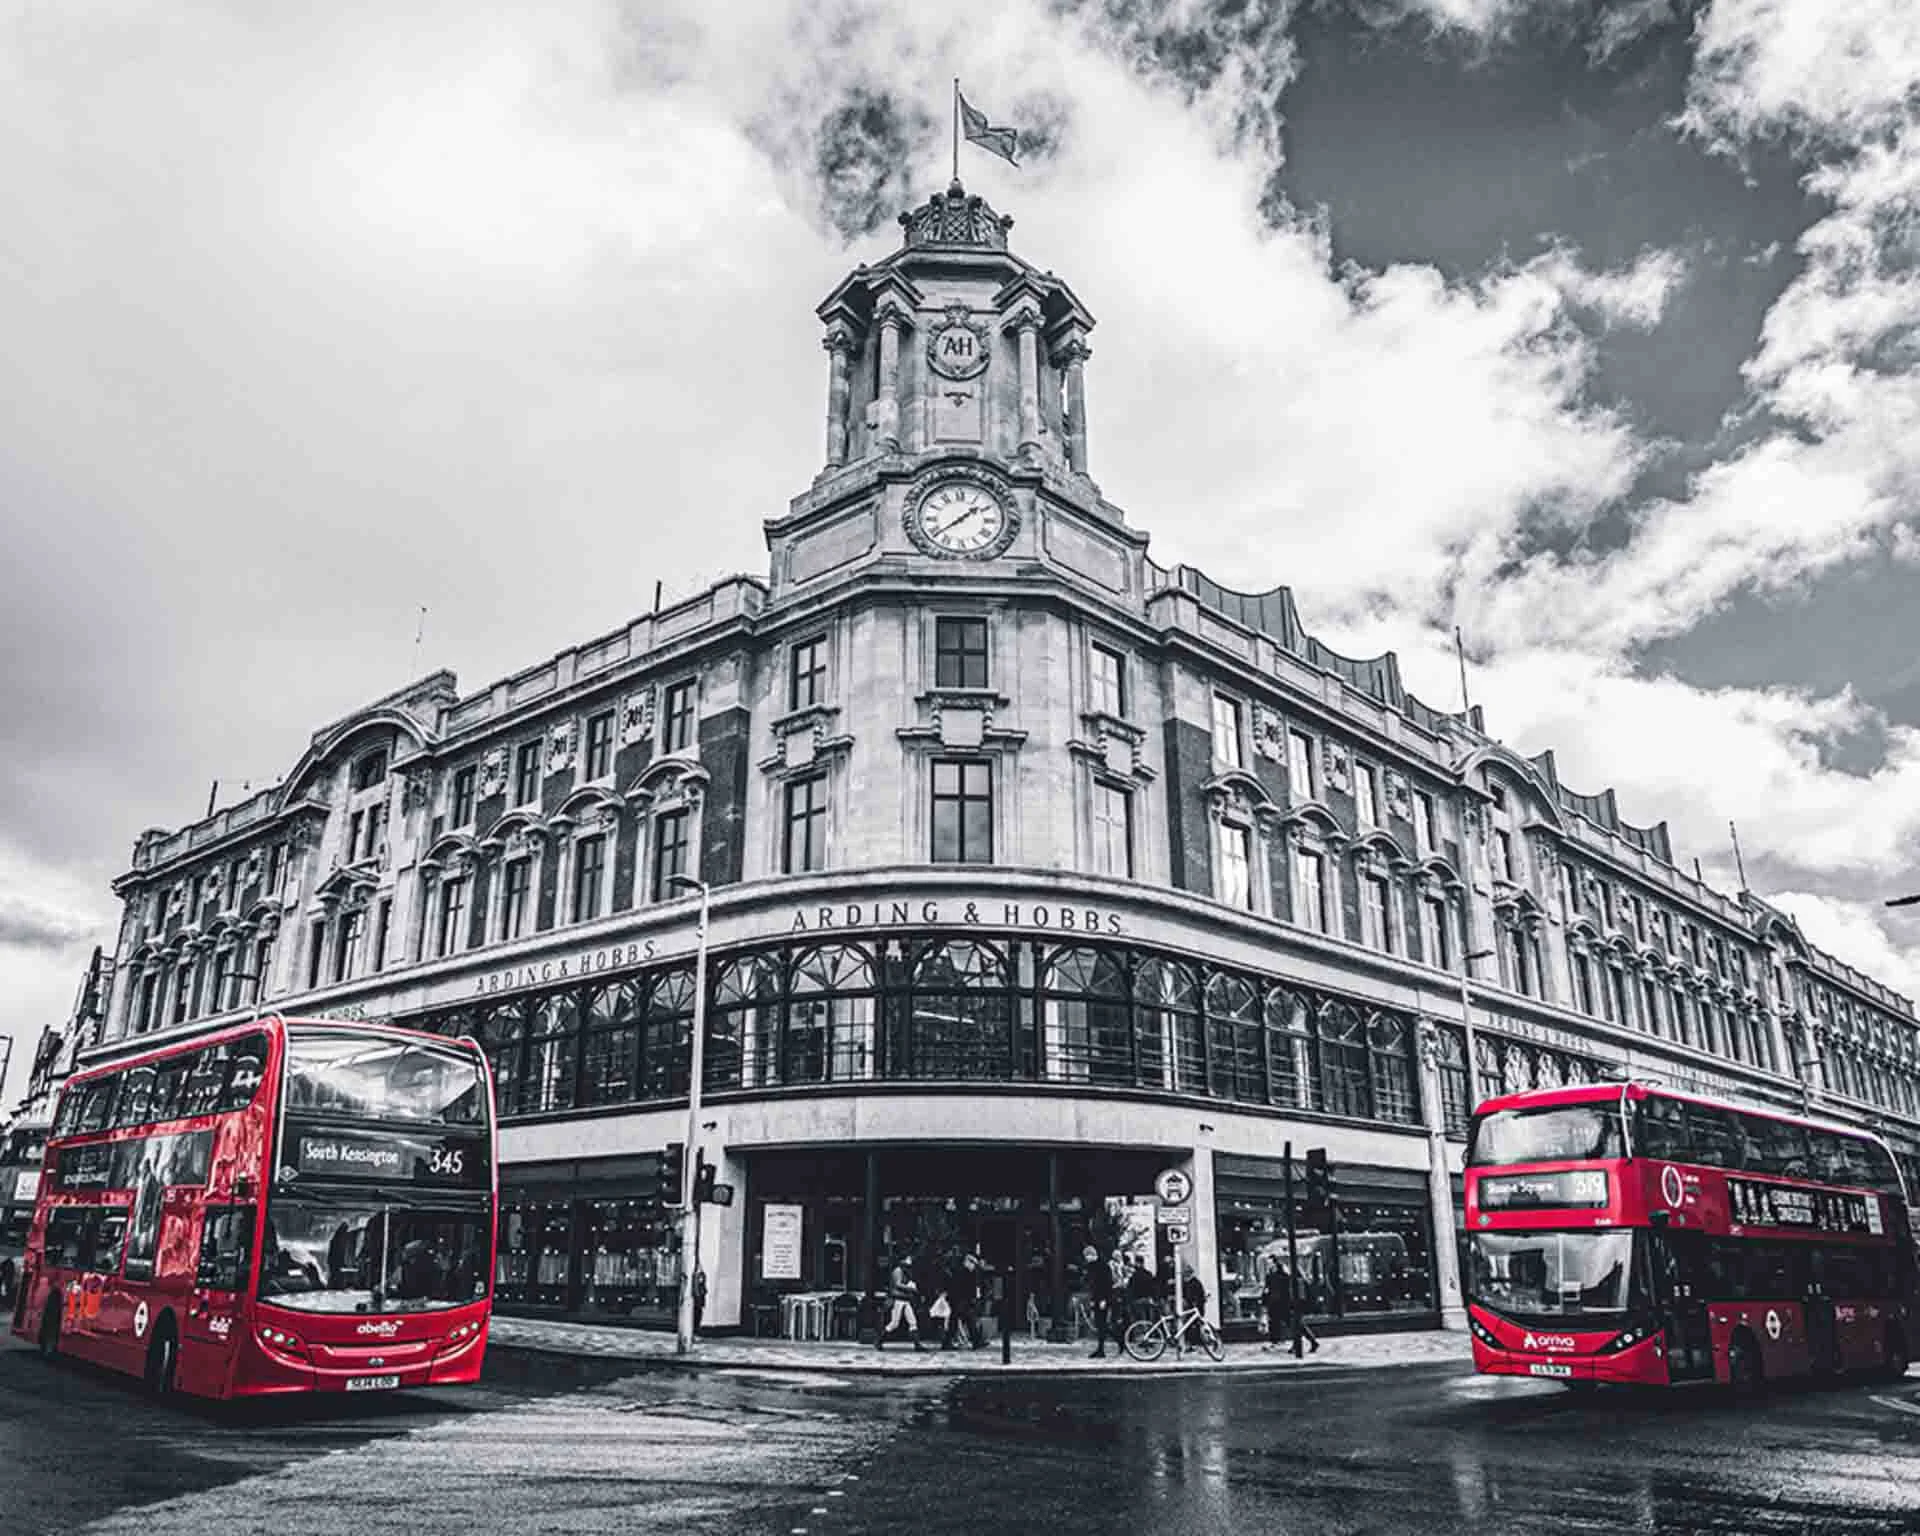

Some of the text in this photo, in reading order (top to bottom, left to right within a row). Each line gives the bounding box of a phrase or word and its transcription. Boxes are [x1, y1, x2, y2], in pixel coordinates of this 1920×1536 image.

[792, 902, 1122, 936] ARDING & HOBBS
[476, 963, 553, 993] ARDING
[580, 939, 656, 974] HOBBS
[306, 1142, 399, 1168] South Kensington
[429, 1149, 463, 1174] 345
[1537, 1334, 1575, 1347] arriva
